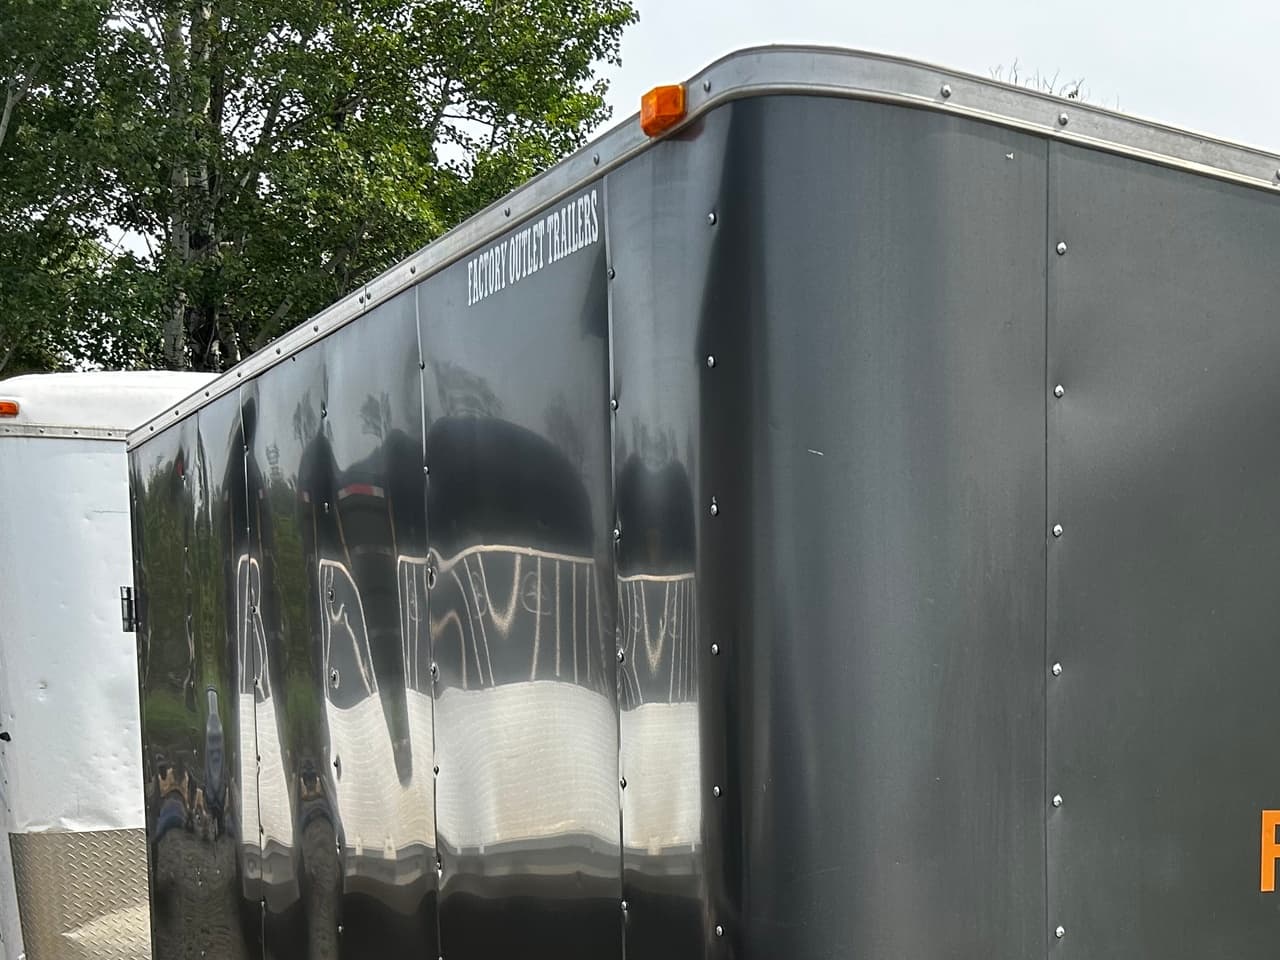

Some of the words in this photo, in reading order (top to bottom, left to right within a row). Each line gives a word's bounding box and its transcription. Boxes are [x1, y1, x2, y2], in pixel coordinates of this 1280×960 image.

[467, 241, 507, 306] FACTORY
[509, 219, 545, 284] OUTLET
[547, 189, 599, 264] TRAILERS
